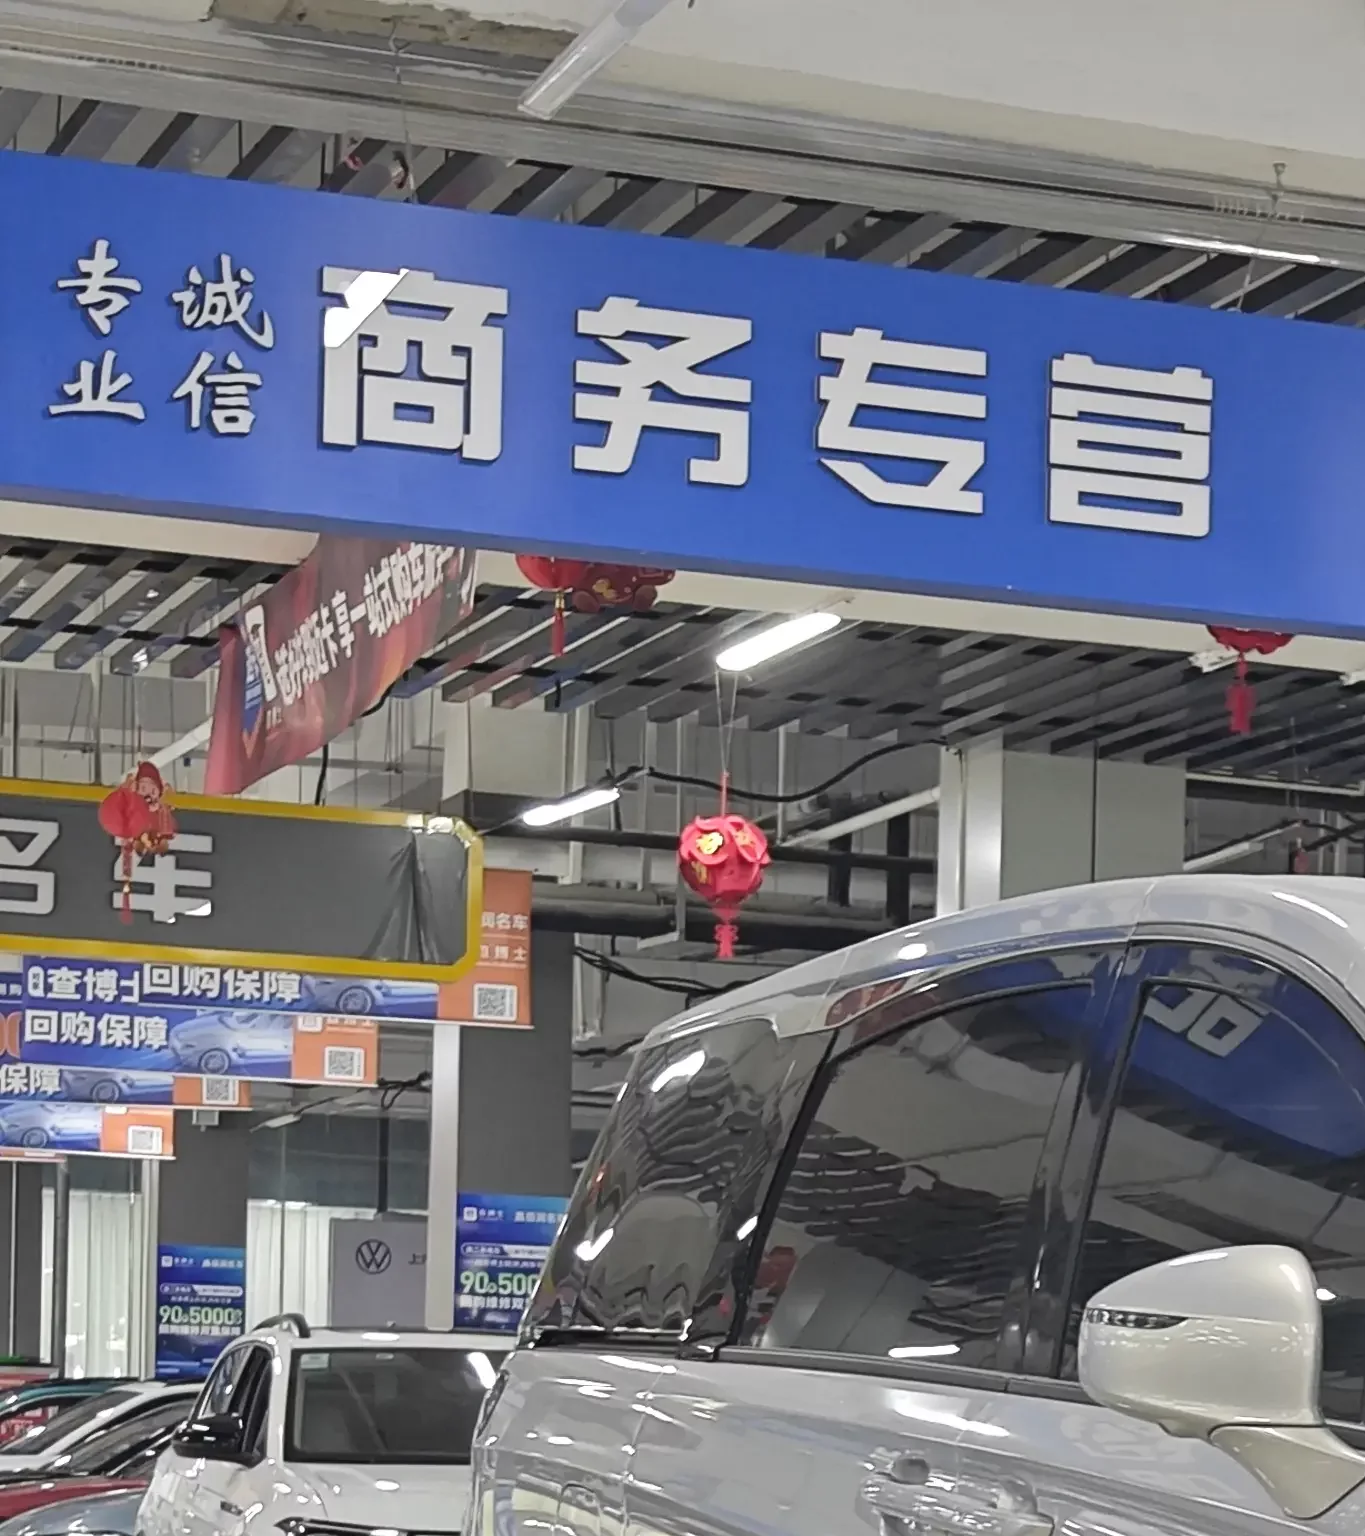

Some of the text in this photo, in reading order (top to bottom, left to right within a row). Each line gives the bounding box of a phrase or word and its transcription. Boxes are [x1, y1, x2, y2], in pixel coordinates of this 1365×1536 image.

[320, 263, 1214, 538] 商务专营
[142, 963, 301, 1003] 回购保障
[24, 1008, 169, 1051] 回购保障
